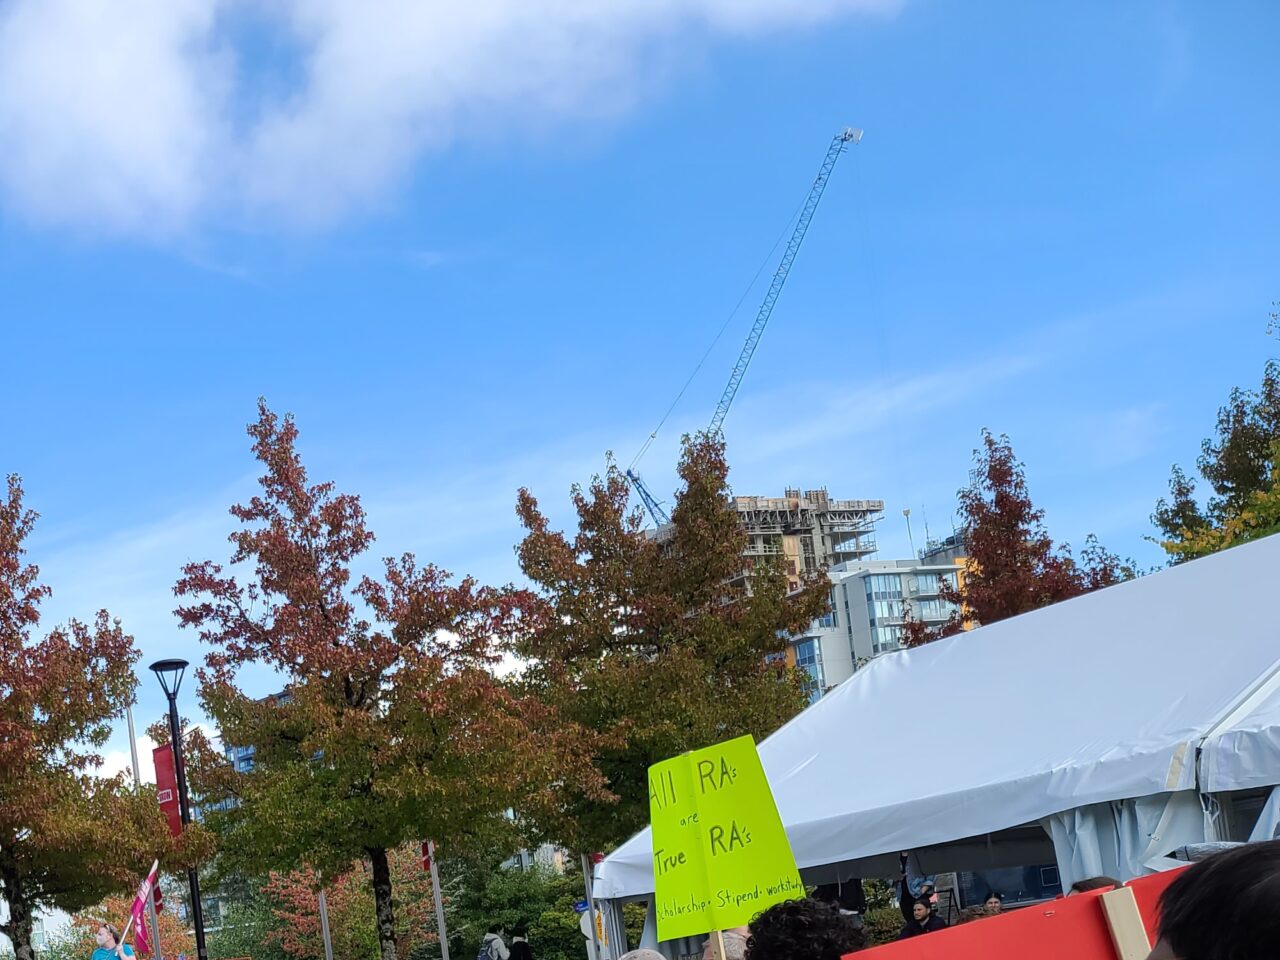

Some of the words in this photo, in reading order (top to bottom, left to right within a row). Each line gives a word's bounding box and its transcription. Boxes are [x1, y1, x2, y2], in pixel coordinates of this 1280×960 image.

[697, 756, 737, 794] RA's
[680, 812, 699, 827] are
[655, 849, 687, 876] True
[709, 820, 752, 856] RA's
[716, 884, 759, 908] Stipend
